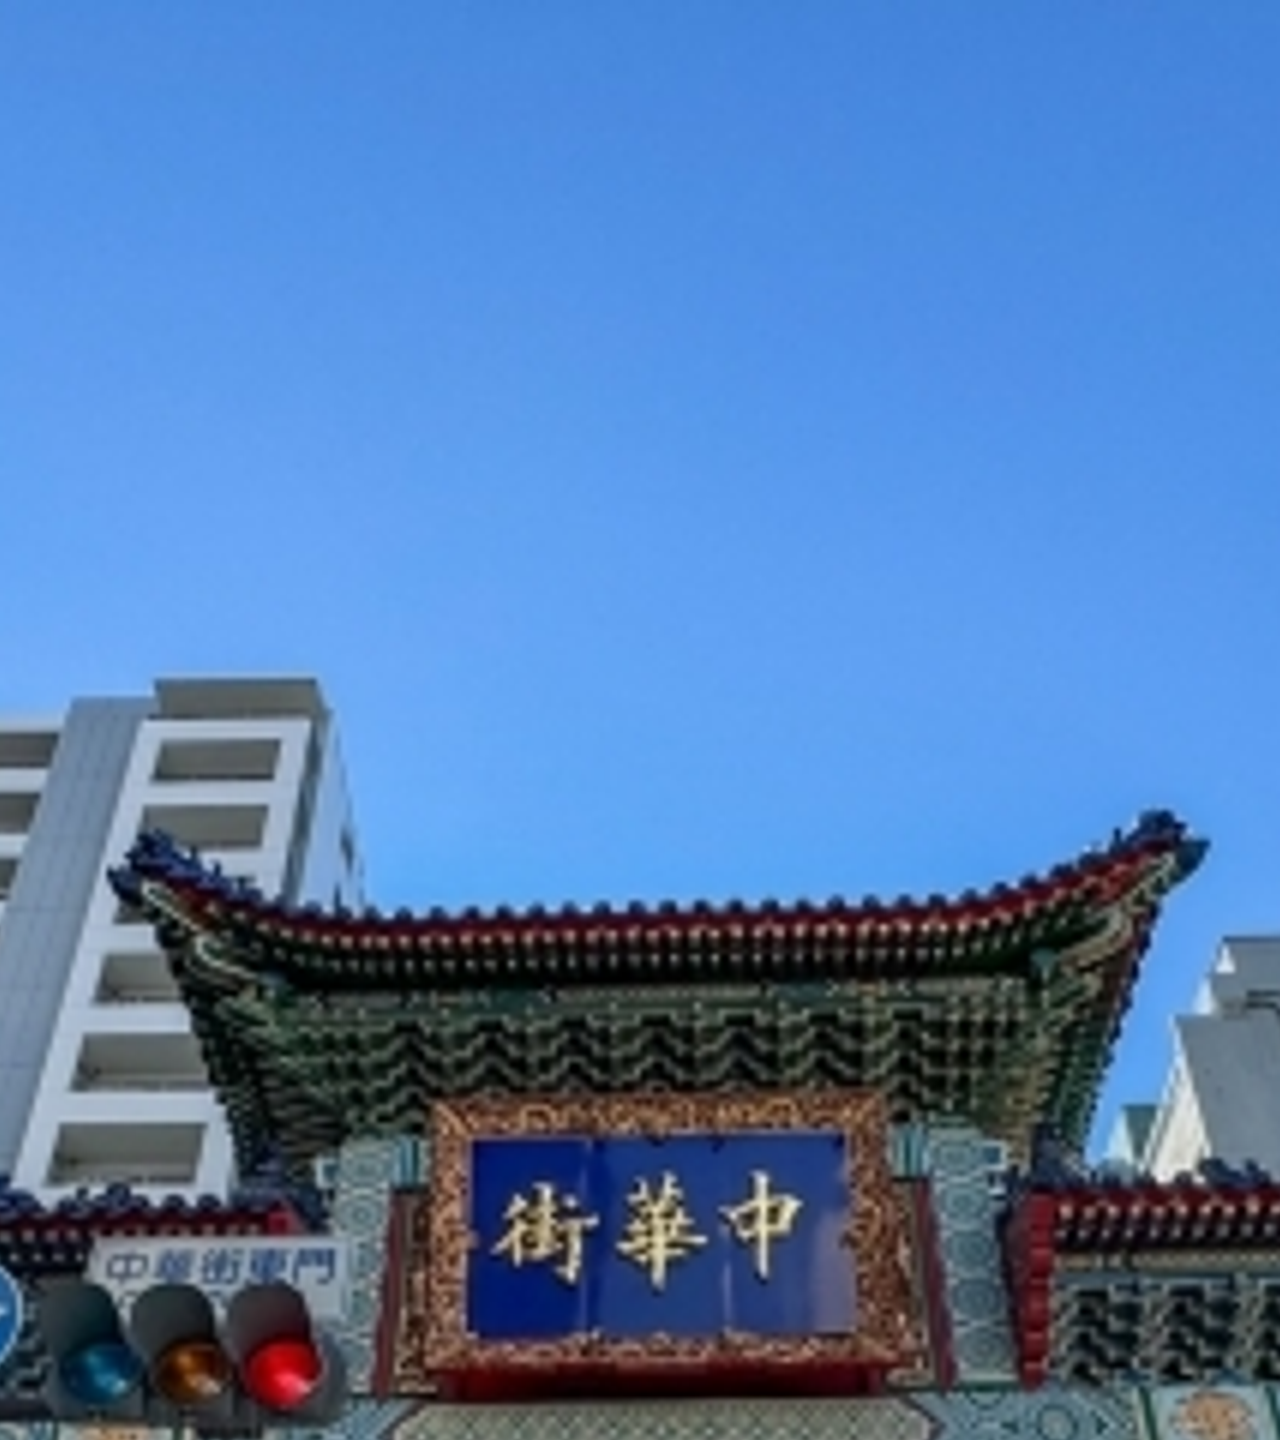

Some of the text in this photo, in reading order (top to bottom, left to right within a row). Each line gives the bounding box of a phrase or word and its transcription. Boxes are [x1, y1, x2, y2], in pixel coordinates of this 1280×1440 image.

[106, 1247, 336, 1285] 中華街東門
